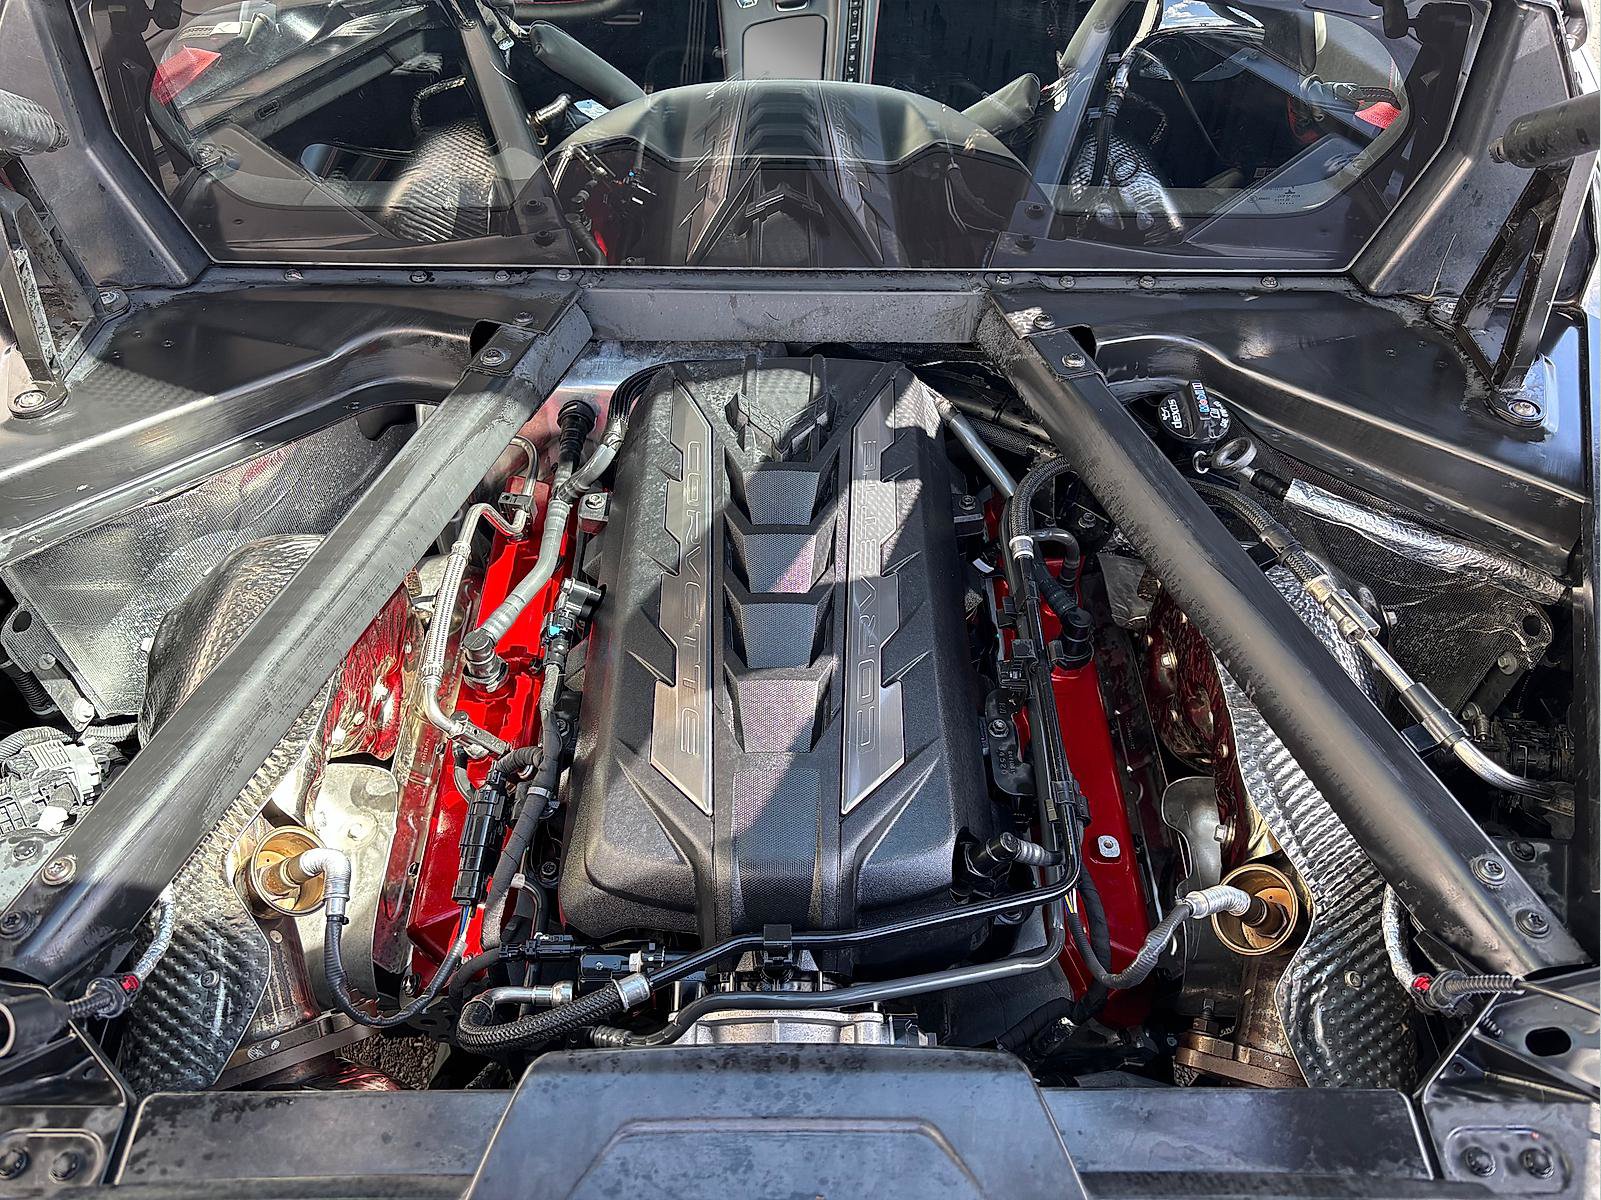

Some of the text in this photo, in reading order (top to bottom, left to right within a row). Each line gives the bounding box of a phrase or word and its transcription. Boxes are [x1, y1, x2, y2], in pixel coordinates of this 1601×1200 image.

[1168, 399, 1182, 429] dexos
[1195, 390, 1210, 413] Mobil
[681, 440, 701, 756] CORVETTE
[856, 440, 877, 753] CORVETTE
